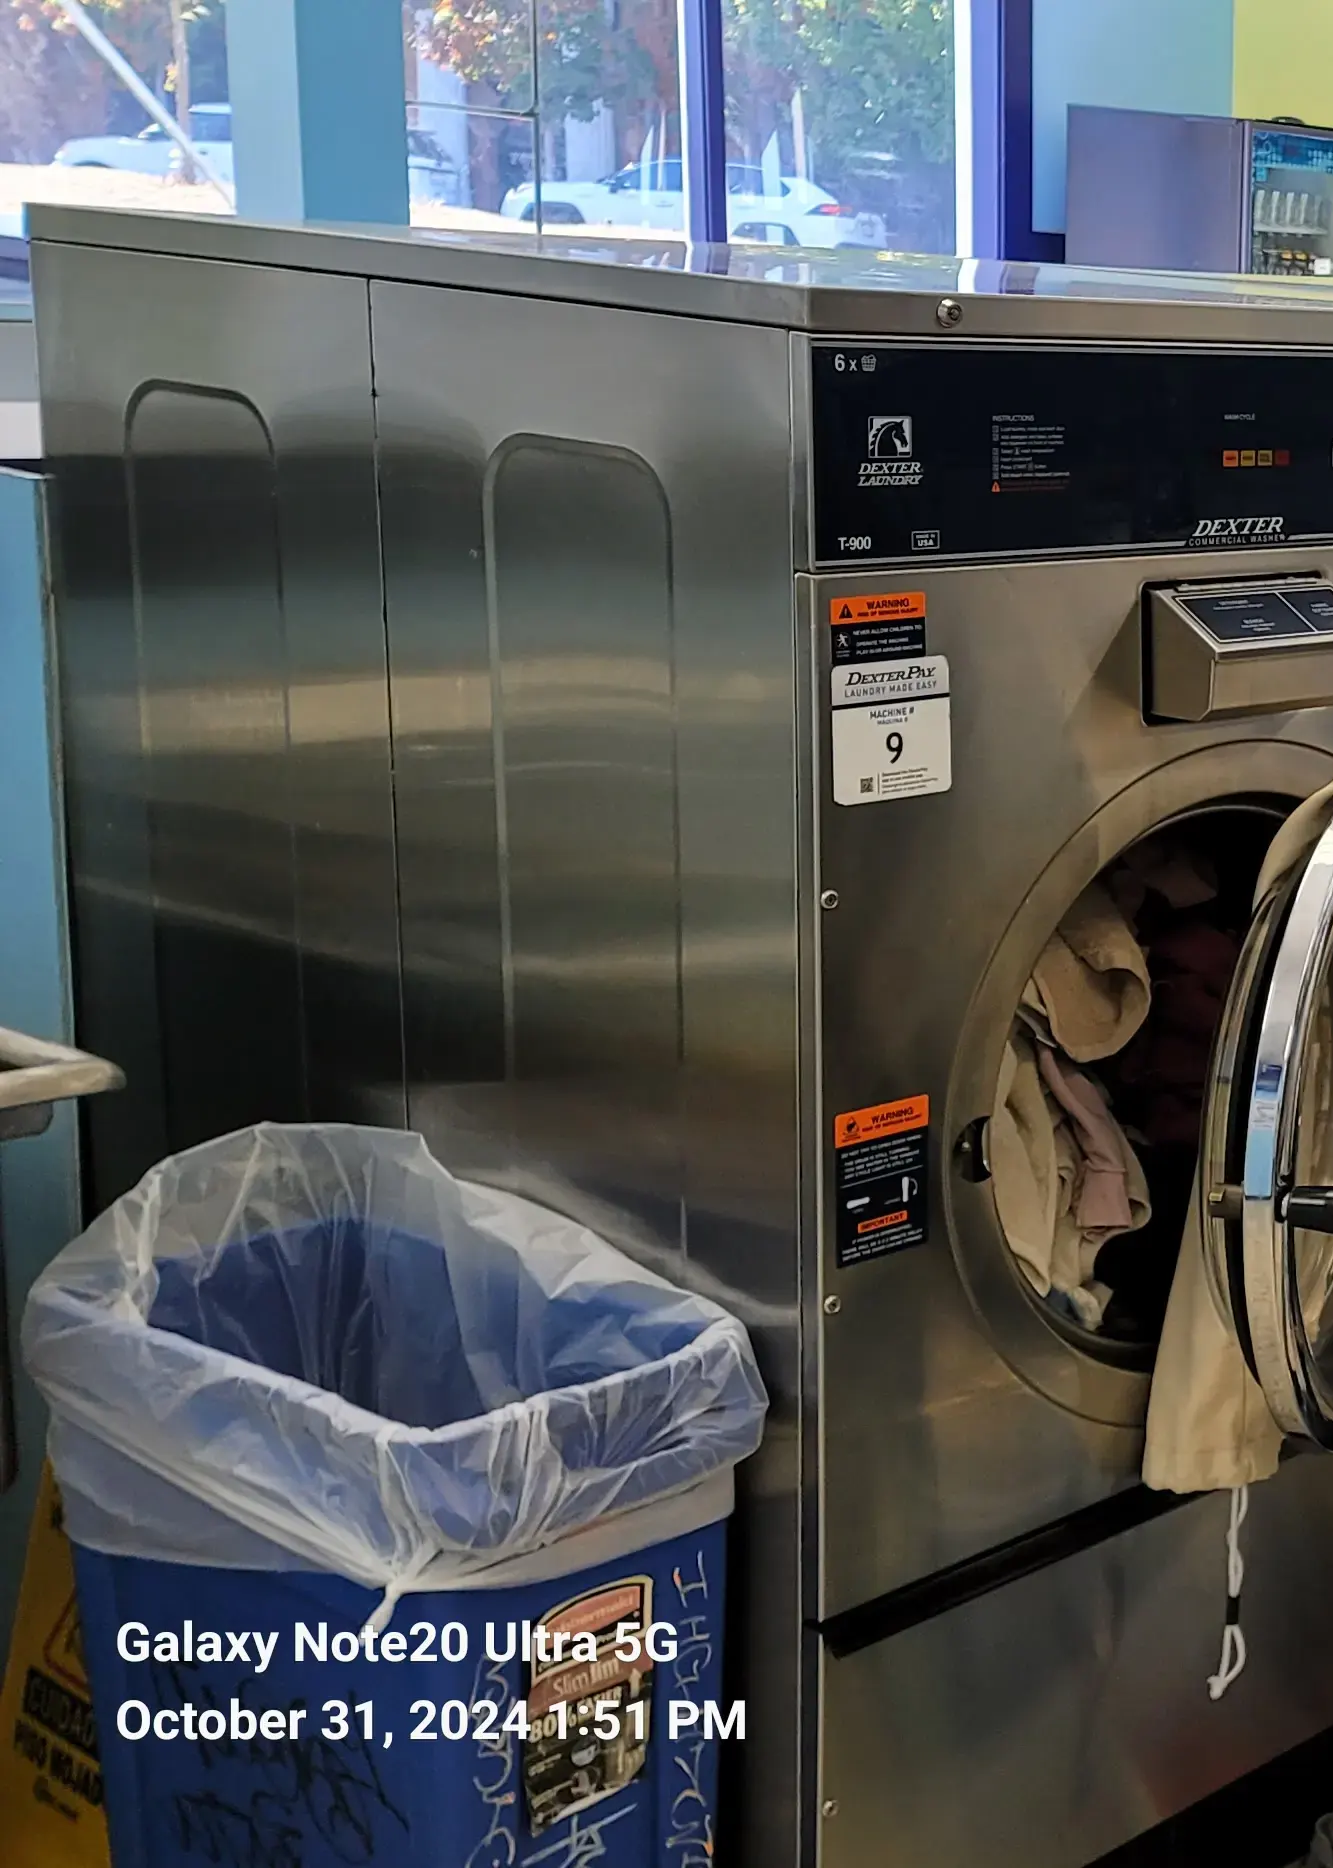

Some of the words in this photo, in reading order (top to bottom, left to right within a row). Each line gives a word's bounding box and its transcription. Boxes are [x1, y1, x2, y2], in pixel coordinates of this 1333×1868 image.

[834, 354, 845, 372] 6
[849, 358, 858, 372] x
[858, 462, 922, 474] DEXTER
[857, 475, 923, 486] LAUNDRY
[1192, 517, 1284, 537] DEXTER
[838, 536, 872, 551] T-900
[917, 539, 934, 547] USA
[1189, 536, 1246, 547] COMMERCIAL
[1250, 534, 1285, 543] WASHER
[867, 598, 910, 610] WARNING
[845, 683, 886, 698] LAUNDRY
[889, 682, 913, 693] MADE
[916, 680, 938, 690] EASY
[870, 707, 907, 719] MACHINE
[885, 732, 904, 764] 9
[871, 1106, 914, 1124] WARNING
[553, 1671, 589, 1697] Slim
